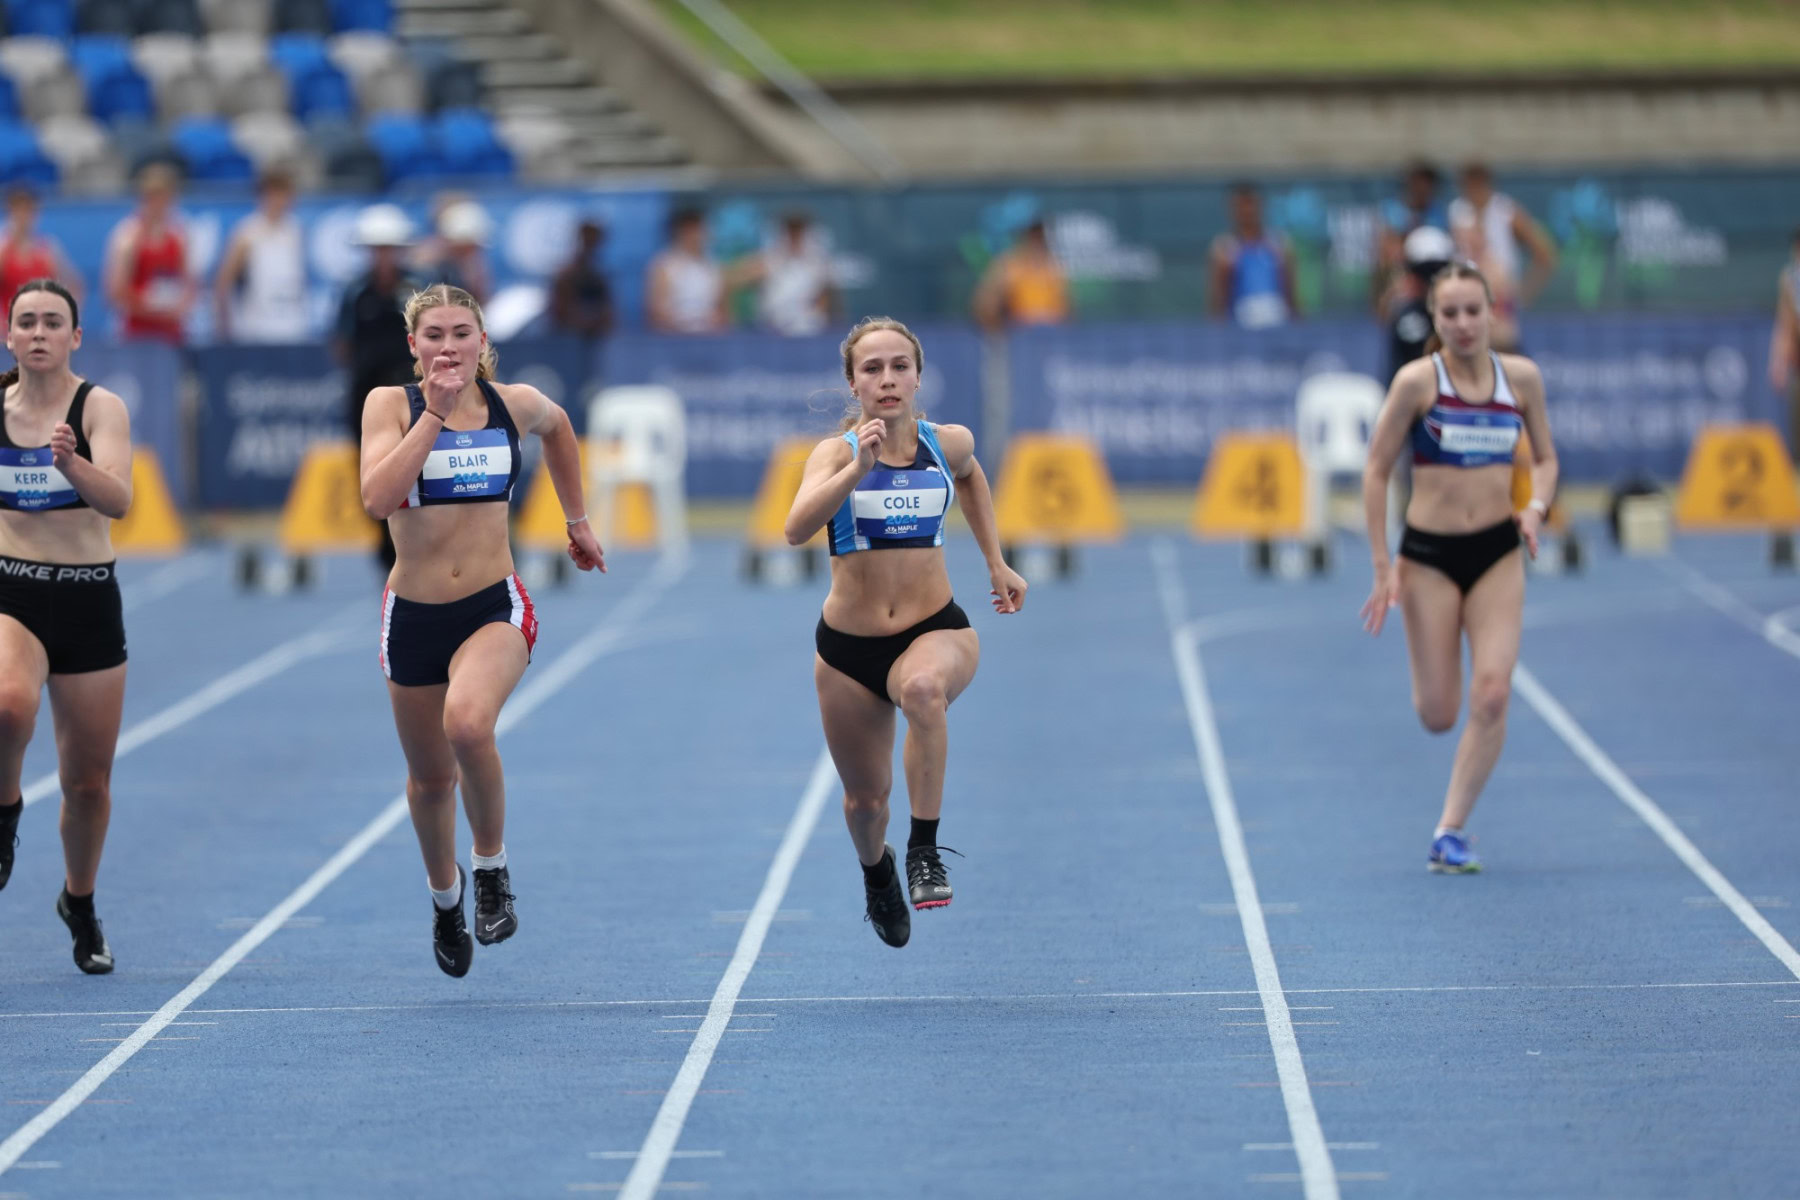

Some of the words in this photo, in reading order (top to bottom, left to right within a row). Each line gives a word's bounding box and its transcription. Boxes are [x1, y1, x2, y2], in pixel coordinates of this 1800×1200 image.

[448, 454, 488, 469] BLAIR
[14, 472, 48, 485] KERR
[453, 471, 488, 483] 2024
[466, 482, 489, 490] MAPLE
[28, 497, 51, 505] MAPLE
[883, 496, 920, 510] COLE
[885, 514, 918, 526] 2024
[897, 524, 919, 532] MAPLE
[0, 559, 54, 581] NIKE
[56, 567, 110, 582] PRO
